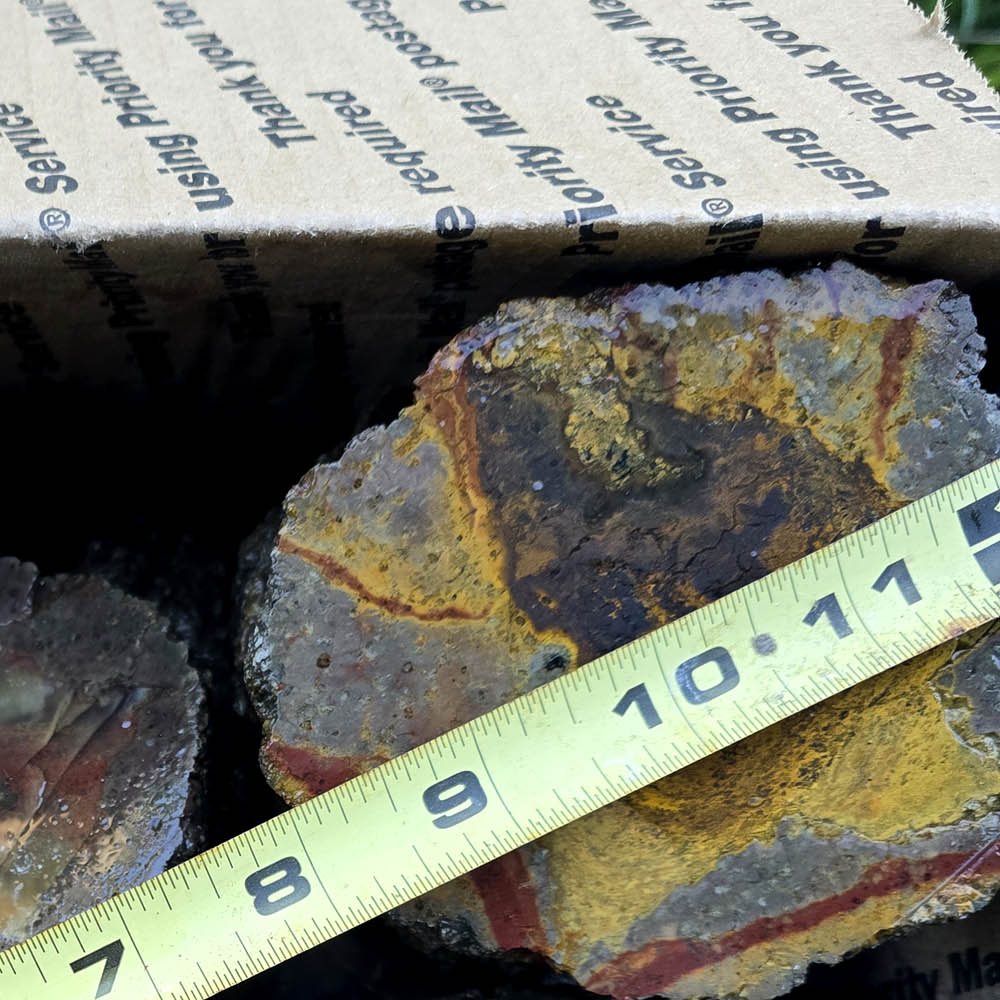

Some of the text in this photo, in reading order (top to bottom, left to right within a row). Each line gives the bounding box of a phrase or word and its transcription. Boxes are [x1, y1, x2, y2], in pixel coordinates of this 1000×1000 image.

[73, 49, 169, 130] Priority
[156, 0, 317, 149] Thank you for
[419, 76, 528, 138] Mail®
[635, 36, 778, 124] Priority
[740, 15, 937, 140] Thank you
[146, 134, 234, 212] using
[306, 90, 455, 195] required
[585, 95, 727, 191] Service
[762, 127, 890, 200] using
[507, 144, 619, 257] Priority
[69, 939, 125, 1000] 7
[244, 856, 311, 916] 8
[423, 770, 487, 829] 9
[612, 646, 740, 729] 10
[802, 558, 922, 640] 11
